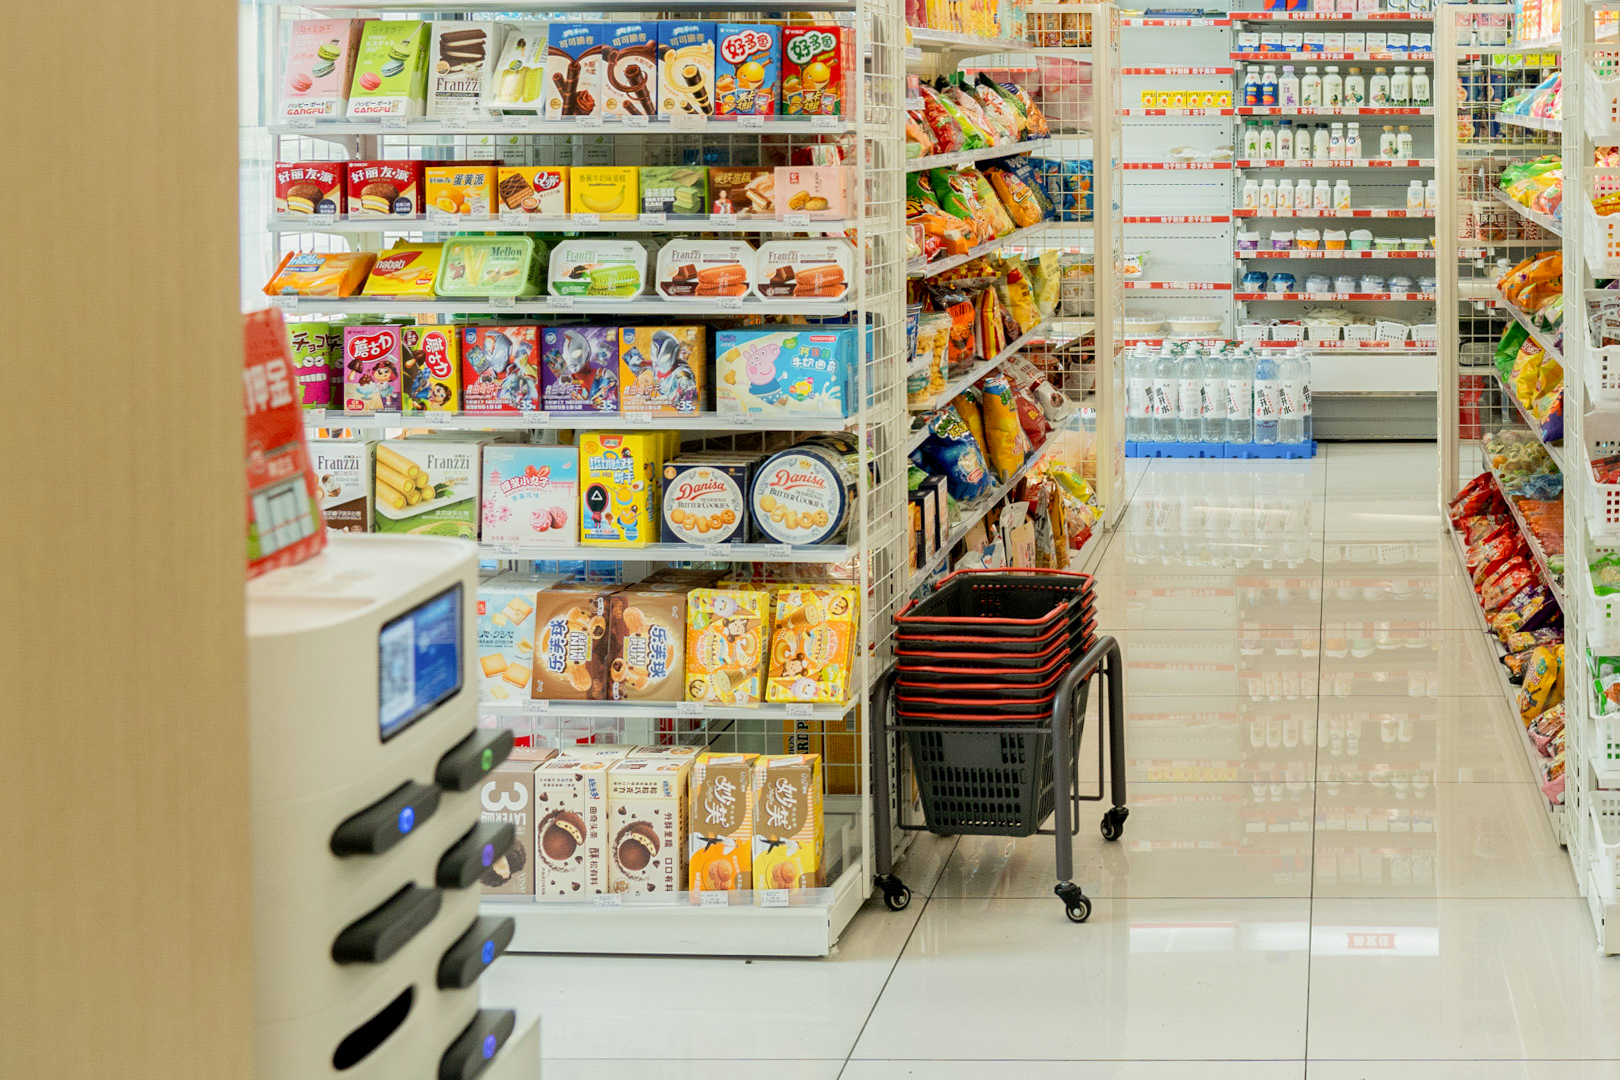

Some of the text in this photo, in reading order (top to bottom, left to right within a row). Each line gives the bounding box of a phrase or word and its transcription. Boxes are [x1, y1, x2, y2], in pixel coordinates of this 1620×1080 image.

[724, 32, 769, 60] 好多鱼
[790, 33, 833, 61] 好多鱼
[287, 107, 325, 115] GANGFU
[354, 106, 391, 114] GANGFU
[452, 173, 485, 186] 蛋黄派
[490, 246, 523, 257] Mellow
[565, 249, 596, 260] Franzzi
[671, 249, 701, 260] Franzzi
[767, 250, 798, 261] Franzzi
[354, 334, 392, 358] 蘑古力
[792, 356, 838, 374] 牛奶曲奇
[318, 456, 359, 470] Franzzi
[427, 455, 470, 470] Franzzi
[500, 476, 550, 494] 爆浆小丸子
[769, 469, 826, 489] Danisa
[678, 480, 728, 500] Danisa
[770, 487, 825, 508] BUTTER COOKIES
[678, 501, 730, 509] BUTTER COOKIES
[549, 620, 569, 673] 乐芙球
[569, 631, 579, 662] MINI
[579, 632, 588, 661] PUFF
[630, 637, 639, 666] PUFF
[639, 637, 647, 666] MINI
[650, 624, 667, 679] 乐芙球
[704, 775, 736, 828] 妙芙
[765, 777, 798, 831] 妙芙
[588, 806, 600, 885] 曲奇头条 酥松有料
[664, 857, 674, 892] 口口有料
